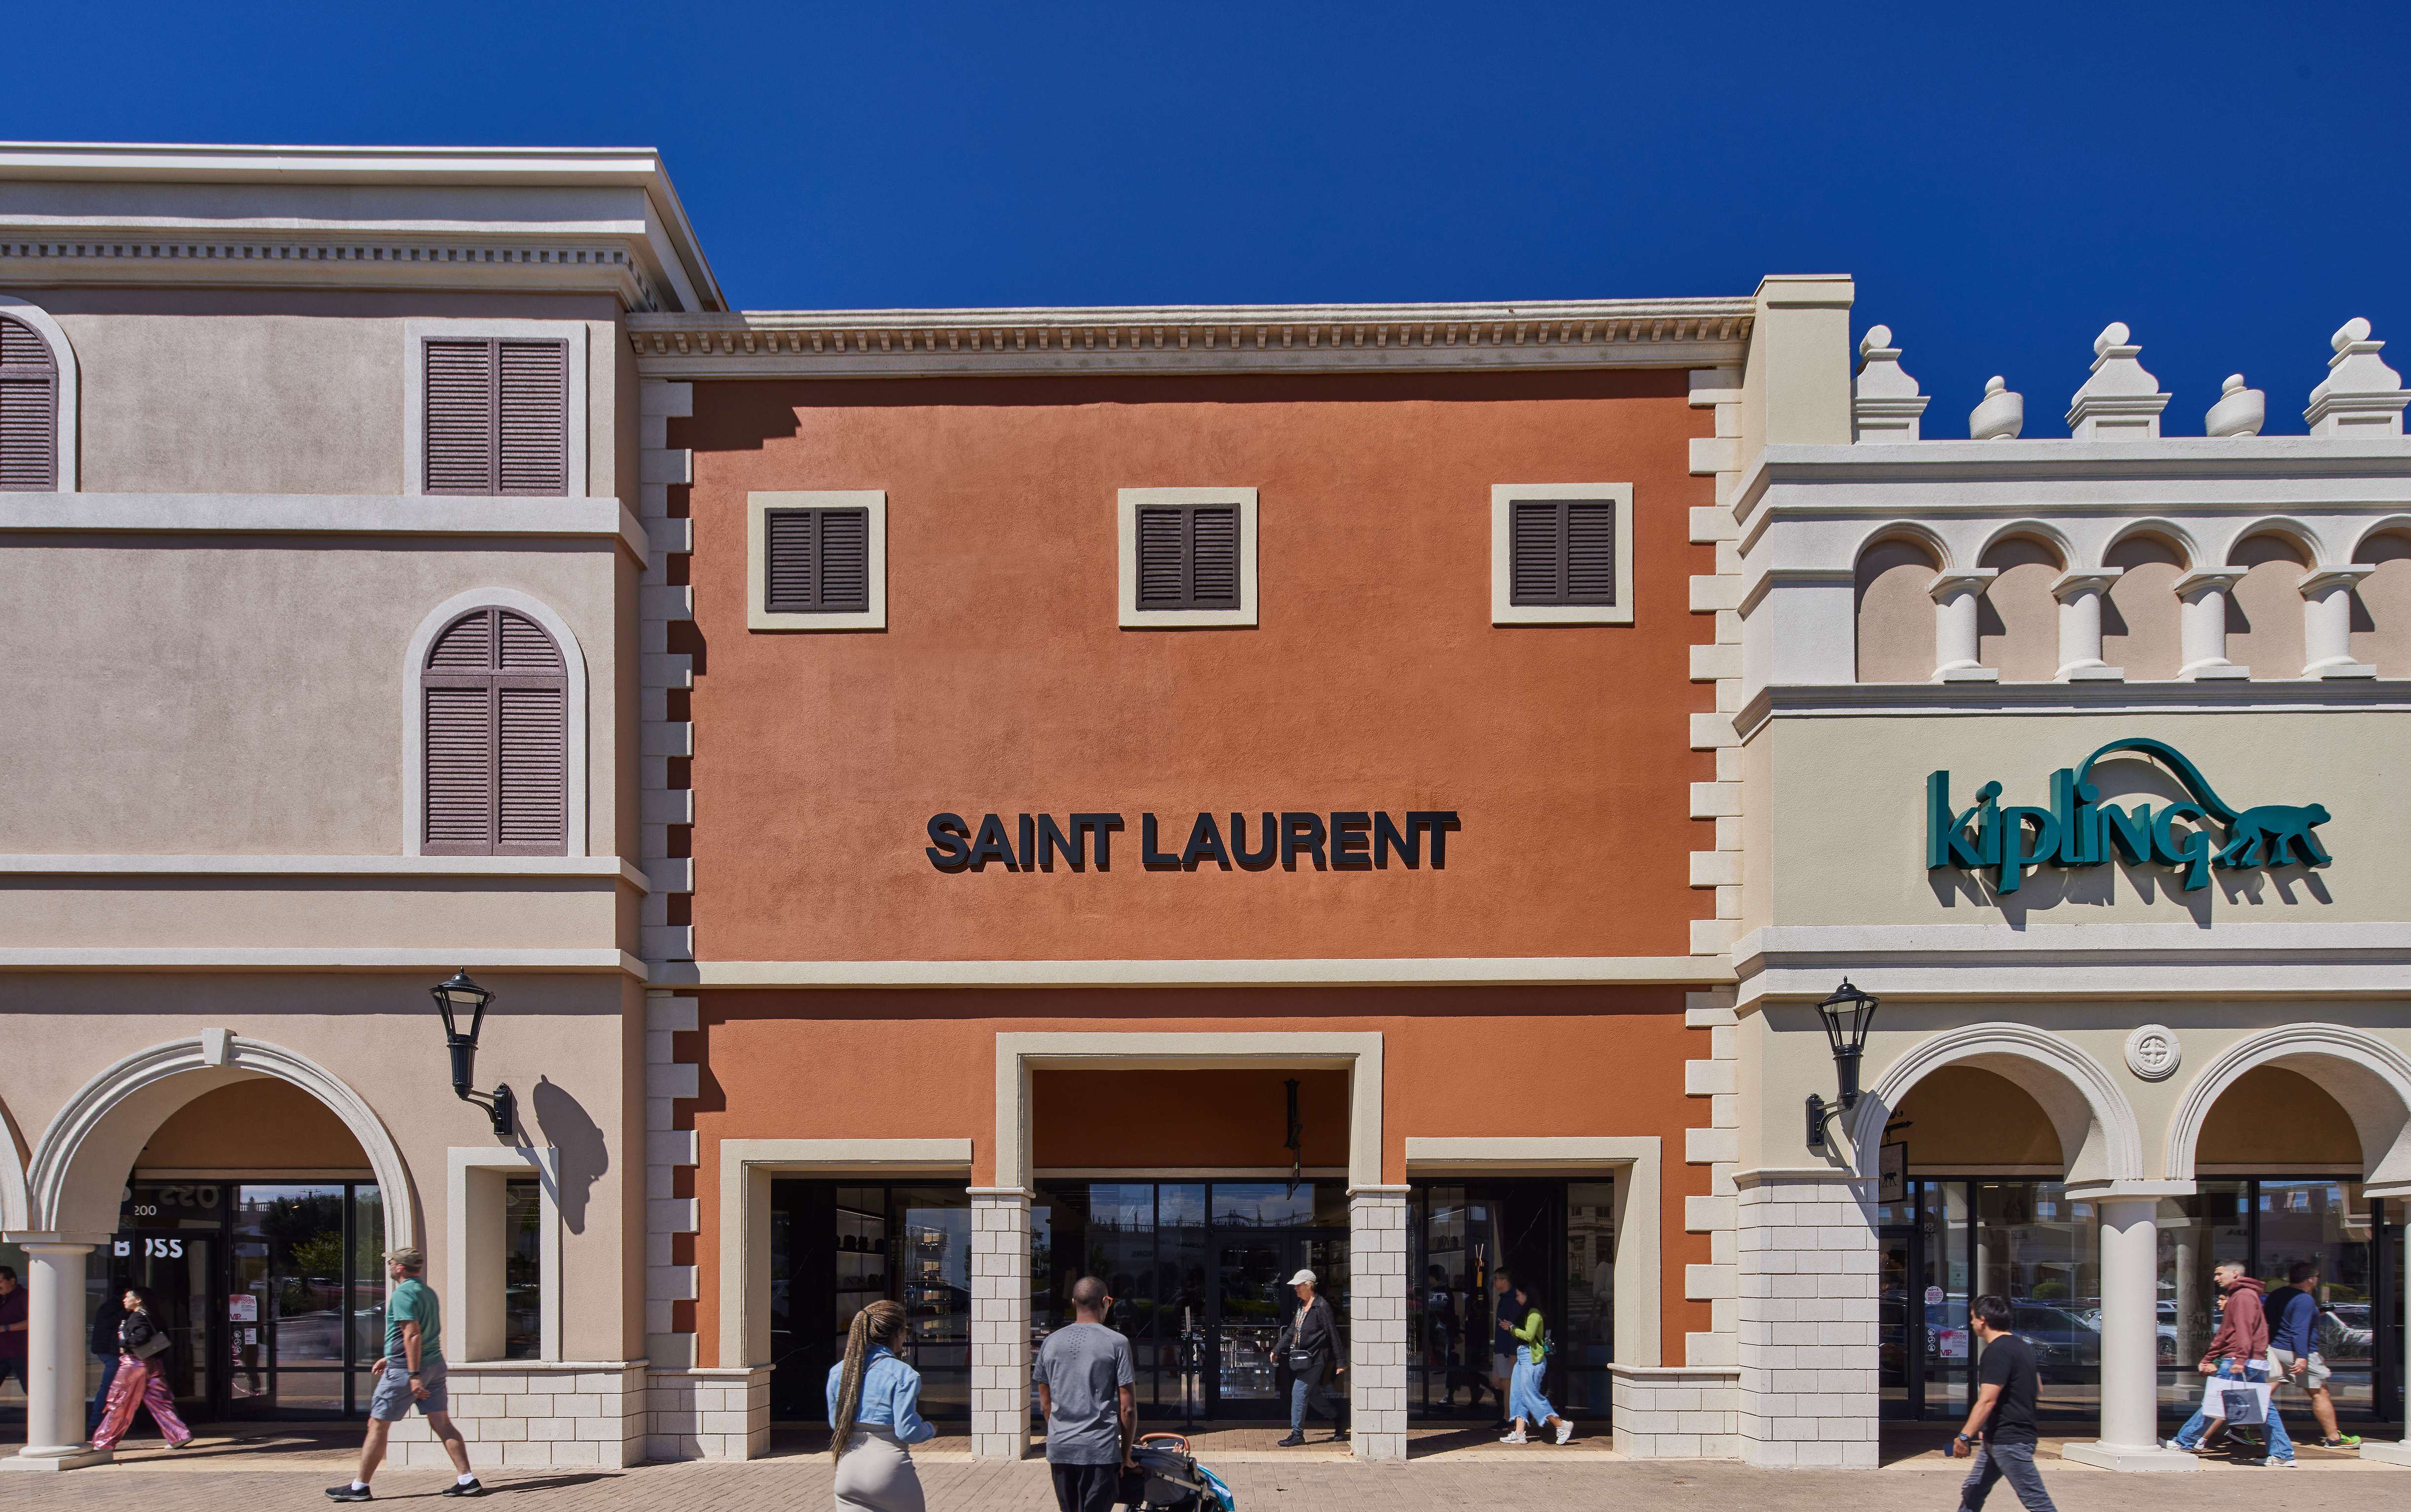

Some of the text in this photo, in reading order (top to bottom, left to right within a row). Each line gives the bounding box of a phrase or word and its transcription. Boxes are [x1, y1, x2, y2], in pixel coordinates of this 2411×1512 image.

[925, 810, 1458, 868] SAINT LAURENT
[135, 1205, 157, 1215] 200
